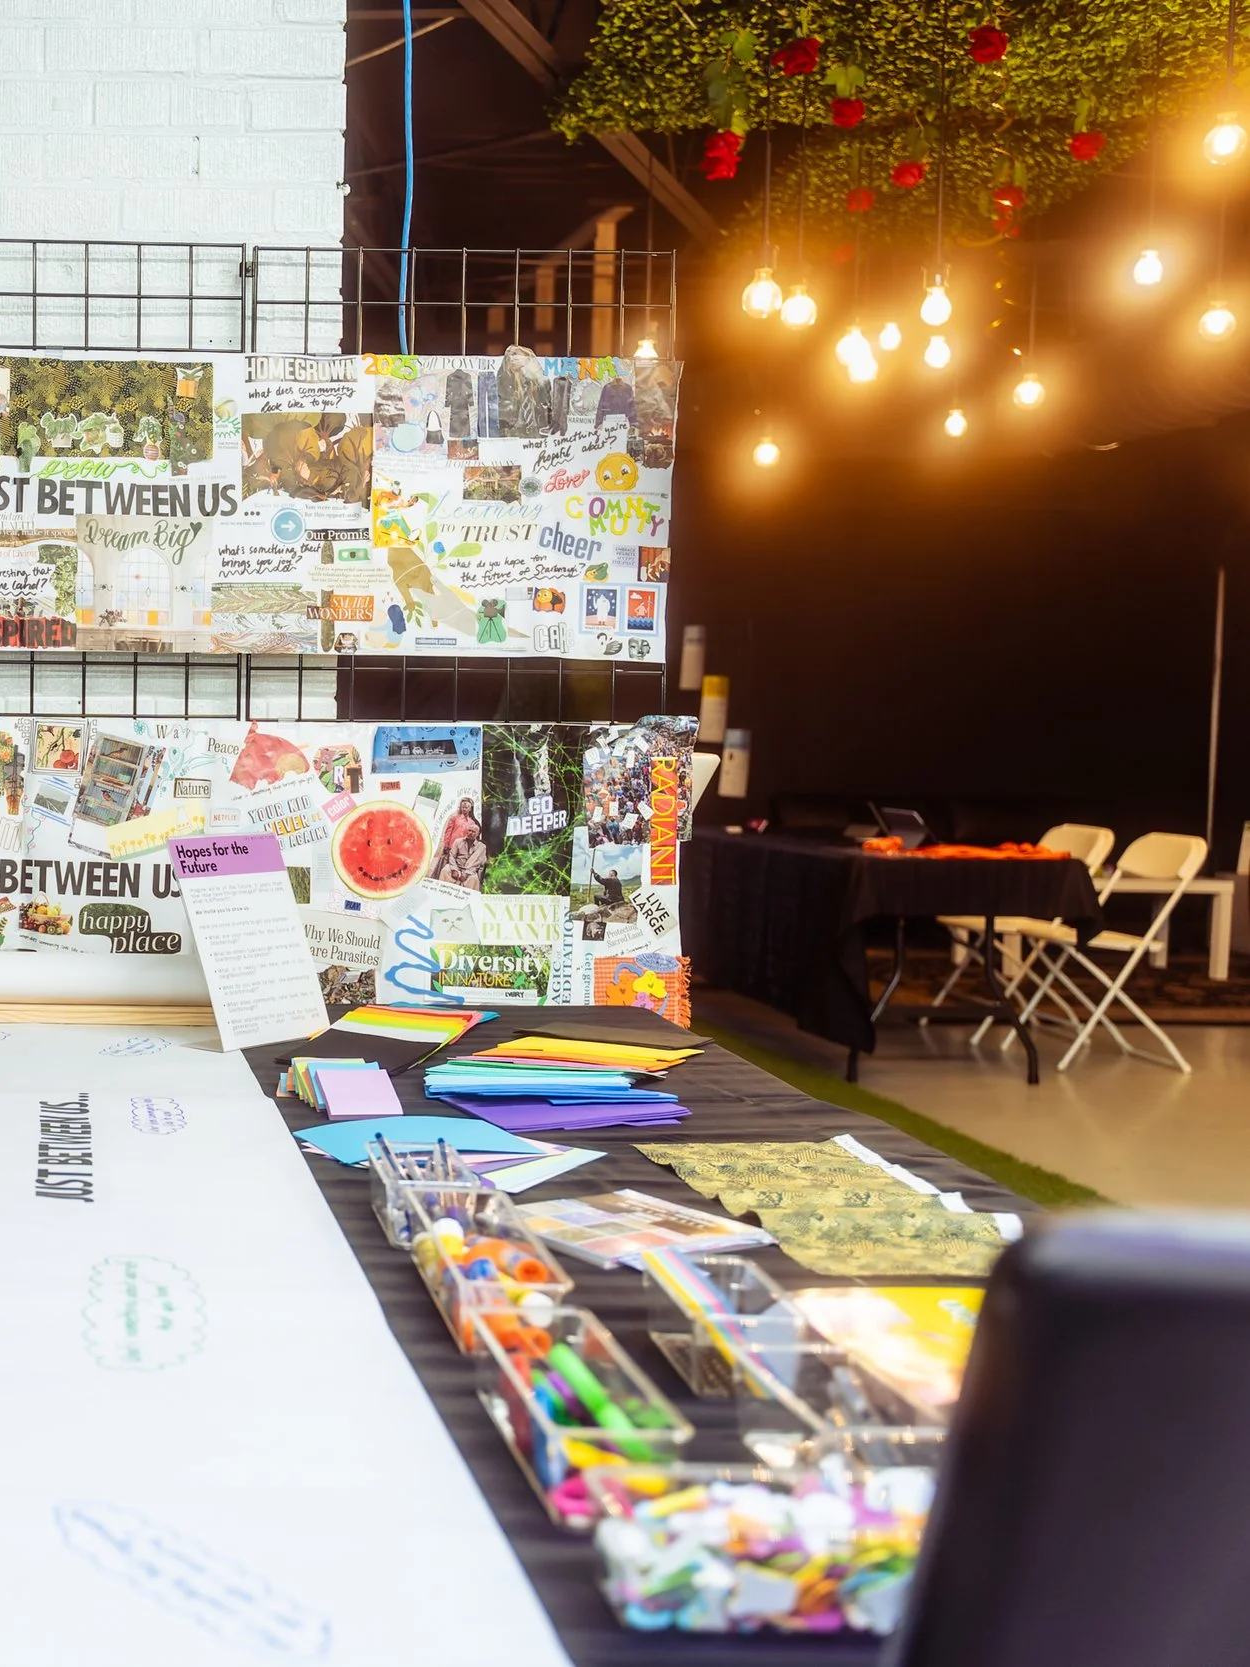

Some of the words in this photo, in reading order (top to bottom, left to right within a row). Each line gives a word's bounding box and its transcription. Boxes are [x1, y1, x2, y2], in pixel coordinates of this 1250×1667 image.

[245, 356, 358, 383] HOMEGROWN
[361, 353, 420, 381] 2025
[442, 358, 496, 370] POWER
[543, 356, 630, 380] MANAL
[248, 388, 271, 400] what
[275, 386, 294, 397] does
[299, 385, 357, 398] community
[261, 401, 283, 413] look
[287, 399, 305, 409] like
[309, 398, 321, 408] to
[322, 396, 343, 411] you?
[568, 416, 596, 425] HARMONY
[522, 439, 548, 450] what's
[553, 428, 602, 447] something
[604, 422, 629, 437] you're
[37, 477, 192, 517] BETWEEN
[427, 490, 546, 523] Learning
[83, 519, 150, 552] Dream
[154, 520, 197, 565] Big
[305, 530, 326, 541] Our
[328, 529, 370, 541] Promis
[440, 523, 456, 533] TO
[461, 523, 539, 543] TRUST
[539, 522, 602, 561] cheer
[218, 545, 246, 556] what's
[249, 545, 298, 558] something
[300, 542, 321, 554] that
[33, 566, 52, 576] that
[221, 557, 251, 569] brings
[256, 558, 273, 571] you
[449, 558, 471, 569] what
[477, 559, 486, 568] do
[489, 559, 501, 571] you
[504, 556, 526, 569] hope
[531, 554, 548, 564] for
[12, 577, 48, 592] land?
[460, 571, 478, 582] the
[482, 570, 513, 585] future
[519, 565, 530, 577] of
[307, 607, 374, 621] WONDERS
[207, 737, 240, 755] Peace
[177, 780, 210, 797] Nature
[381, 781, 401, 790] HOME
[248, 802, 284, 824] YOUR
[288, 795, 311, 813] KID
[327, 797, 350, 816] color
[528, 797, 554, 815] GO
[507, 810, 568, 836] DEEPER
[651, 757, 676, 885] RADIANT
[176, 844, 212, 860] Hopes
[212, 842, 230, 856] for
[232, 841, 249, 855] the
[181, 860, 218, 874] Future
[0, 859, 141, 898] BETWEEN
[481, 903, 560, 922] NATIVE
[632, 893, 665, 936] LARGE
[646, 893, 670, 922] LIVE
[82, 911, 149, 933] happy
[482, 922, 561, 942] PLANTS
[111, 933, 181, 954] place
[328, 927, 344, 943] We
[343, 930, 381, 950] Should
[330, 945, 380, 966] Parasites
[440, 949, 546, 979] Diversity
[439, 973, 450, 986] IN
[451, 973, 512, 988] NATURE
[38, 1115, 93, 1166] BETWEEN
[35, 1168, 94, 1203] JUST
